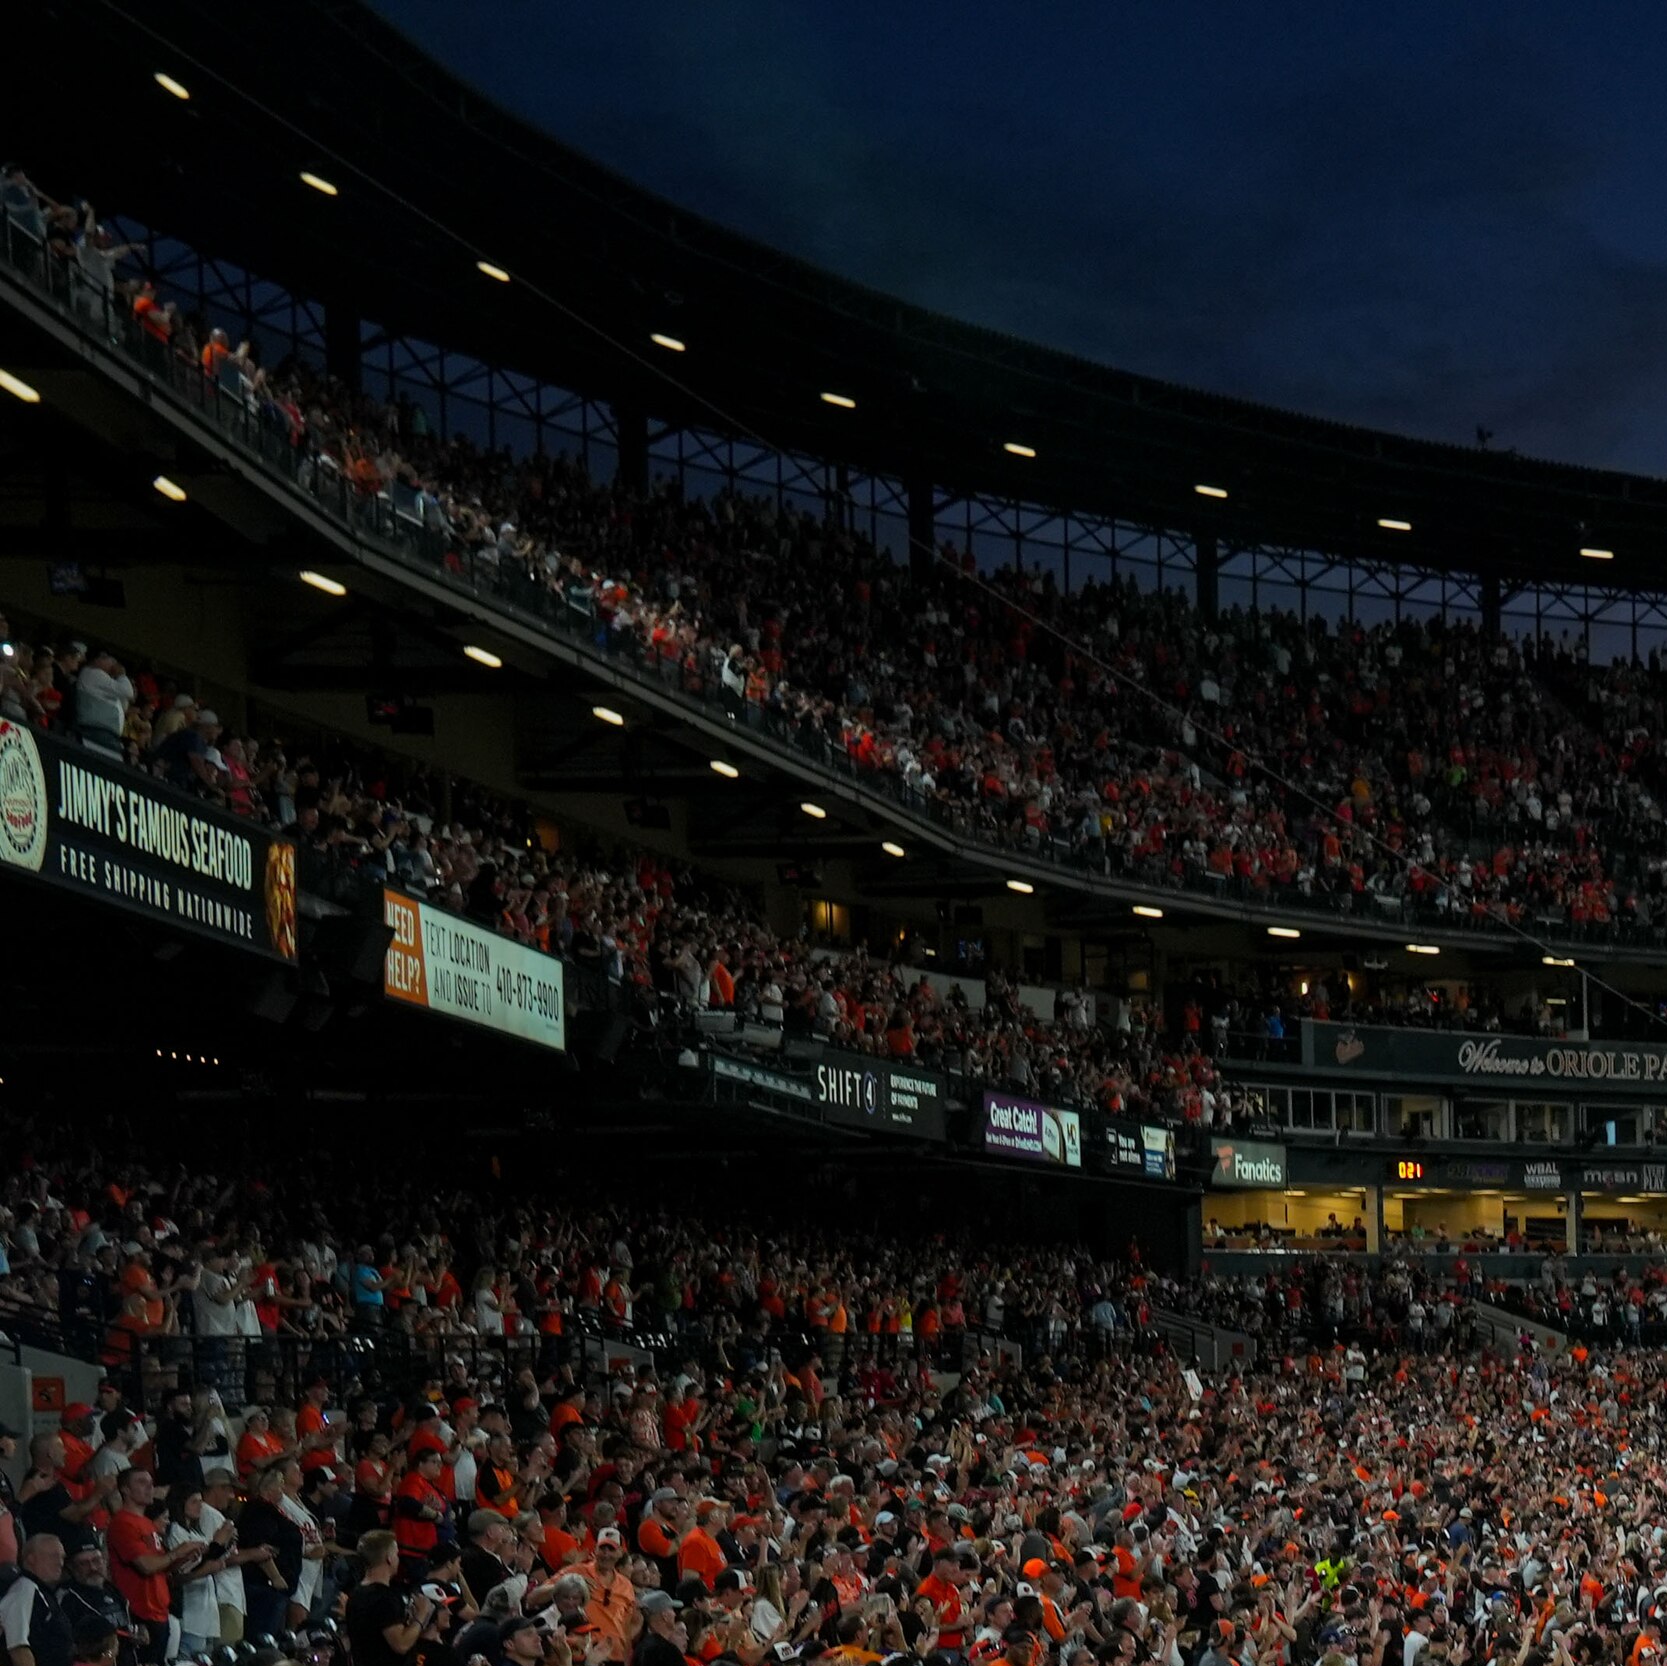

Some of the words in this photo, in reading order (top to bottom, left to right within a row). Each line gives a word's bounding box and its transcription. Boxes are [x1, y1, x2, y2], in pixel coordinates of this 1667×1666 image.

[58, 759, 127, 843] JIMMY'S
[129, 790, 190, 869] FAMOUS
[191, 816, 251, 891] SEAFOOD
[60, 844, 97, 884] FREE
[104, 860, 170, 911] SHIPPING
[177, 887, 253, 939] NATIONWIDE
[387, 900, 414, 947] NEED
[387, 948, 420, 994] HELP?
[424, 920, 446, 957] TEXT
[449, 928, 491, 977] LOCATION
[434, 966, 451, 1003] AND
[454, 971, 479, 1012] ISSUE
[482, 982, 492, 1016] TO
[496, 963, 560, 1022] 410-873-9900
[1458, 1040, 1531, 1074] Welcome
[1546, 1049, 1641, 1078] ORIOLE
[990, 1101, 1013, 1130] Great
[1013, 1106, 1038, 1135] Catch!
[1234, 1154, 1282, 1183] Fanatics
[1525, 1162, 1559, 1175] WBAL
